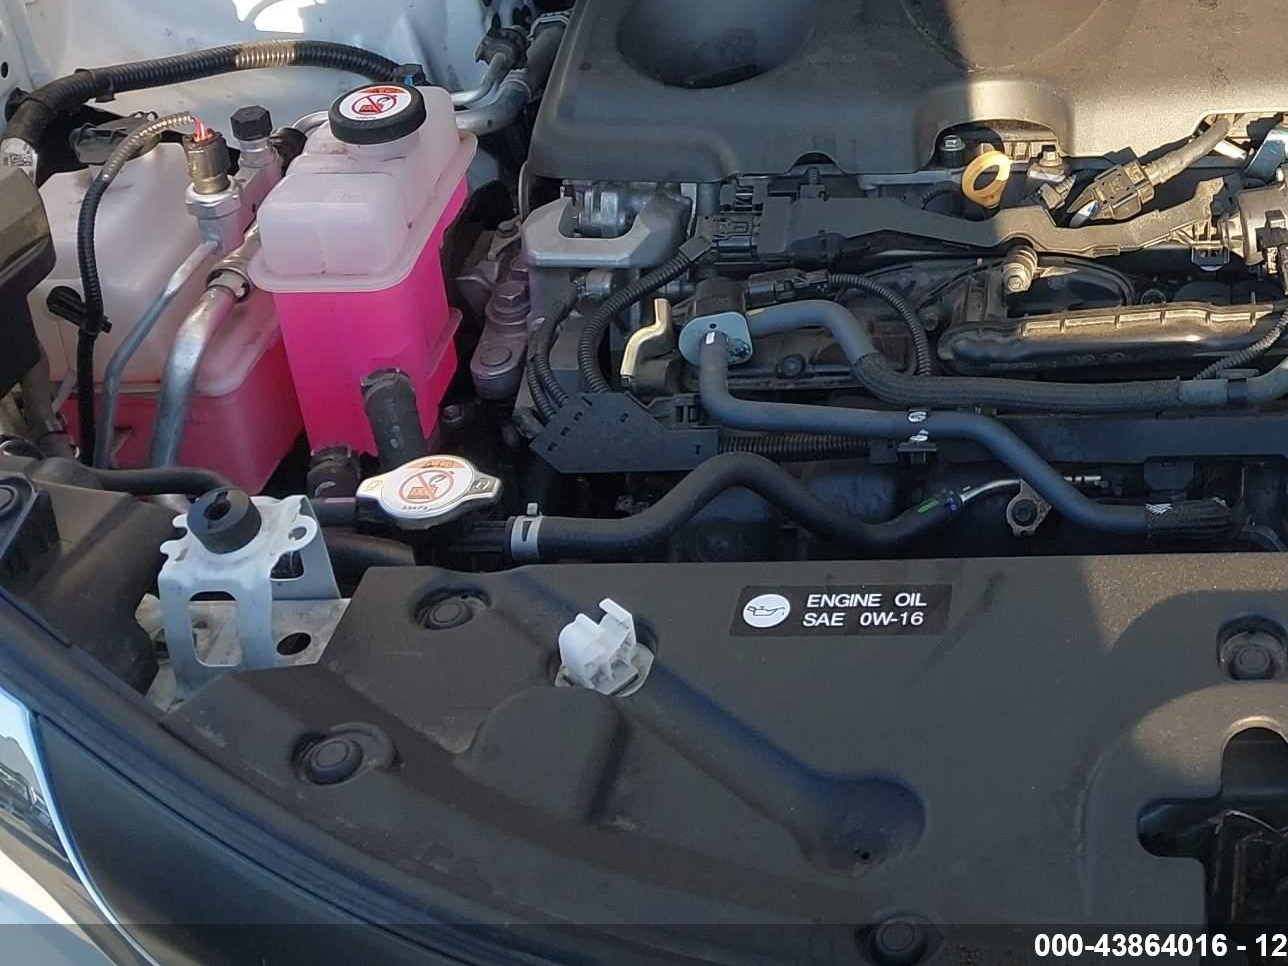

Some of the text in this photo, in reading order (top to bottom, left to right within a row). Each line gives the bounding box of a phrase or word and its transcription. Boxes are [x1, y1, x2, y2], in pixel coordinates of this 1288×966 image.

[806, 592, 927, 607] ENGINE OIL
[802, 611, 924, 627] SAE 0W-16
